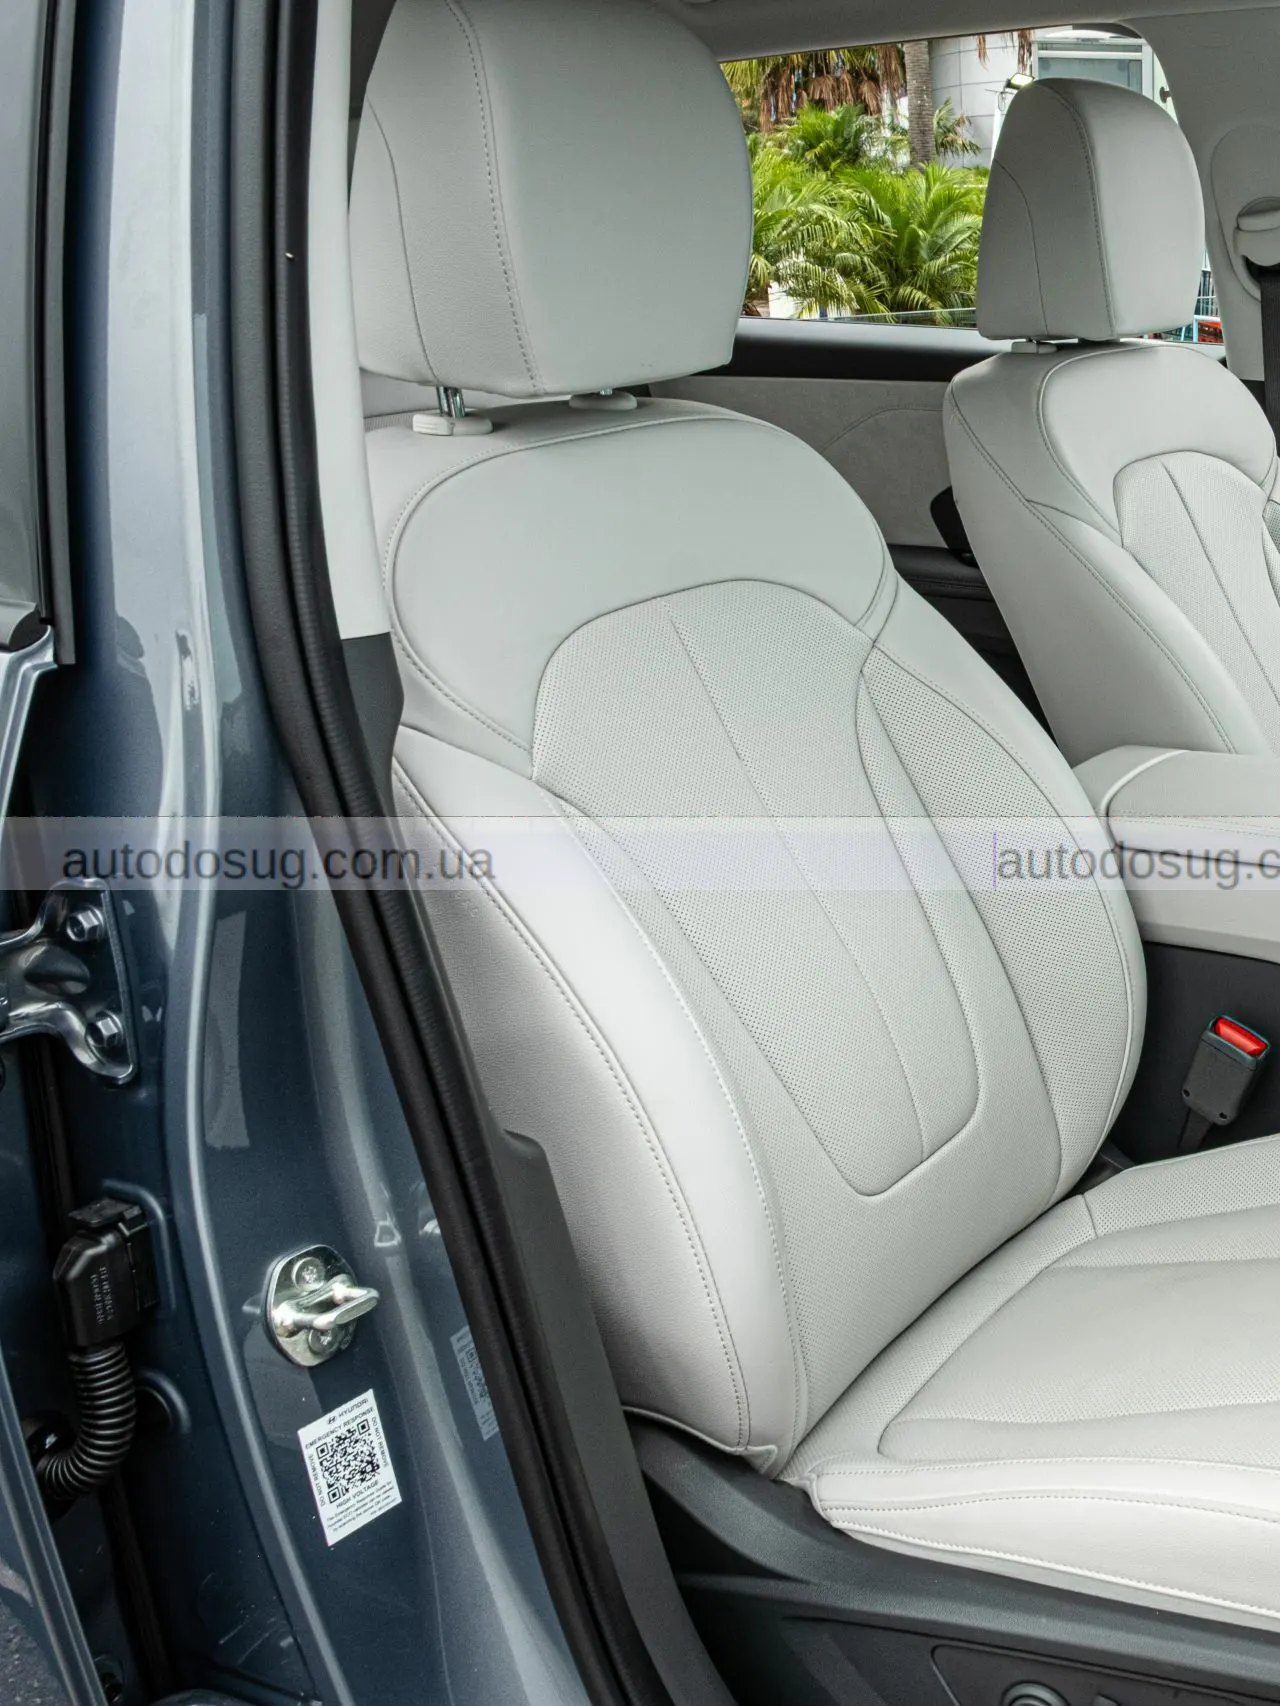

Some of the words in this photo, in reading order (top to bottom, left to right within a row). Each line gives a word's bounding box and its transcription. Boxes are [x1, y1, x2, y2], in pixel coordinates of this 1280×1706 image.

[338, 1398, 368, 1417] HYUNDAI
[305, 1425, 341, 1448] EMERGENCY
[343, 1407, 373, 1427] RESPONSE
[371, 1417, 377, 1426] DO
[378, 1441, 388, 1467] REMOVE
[319, 1496, 325, 1506] DO
[336, 1496, 350, 1508] HIGH
[352, 1480, 378, 1498] VOLTAGE
